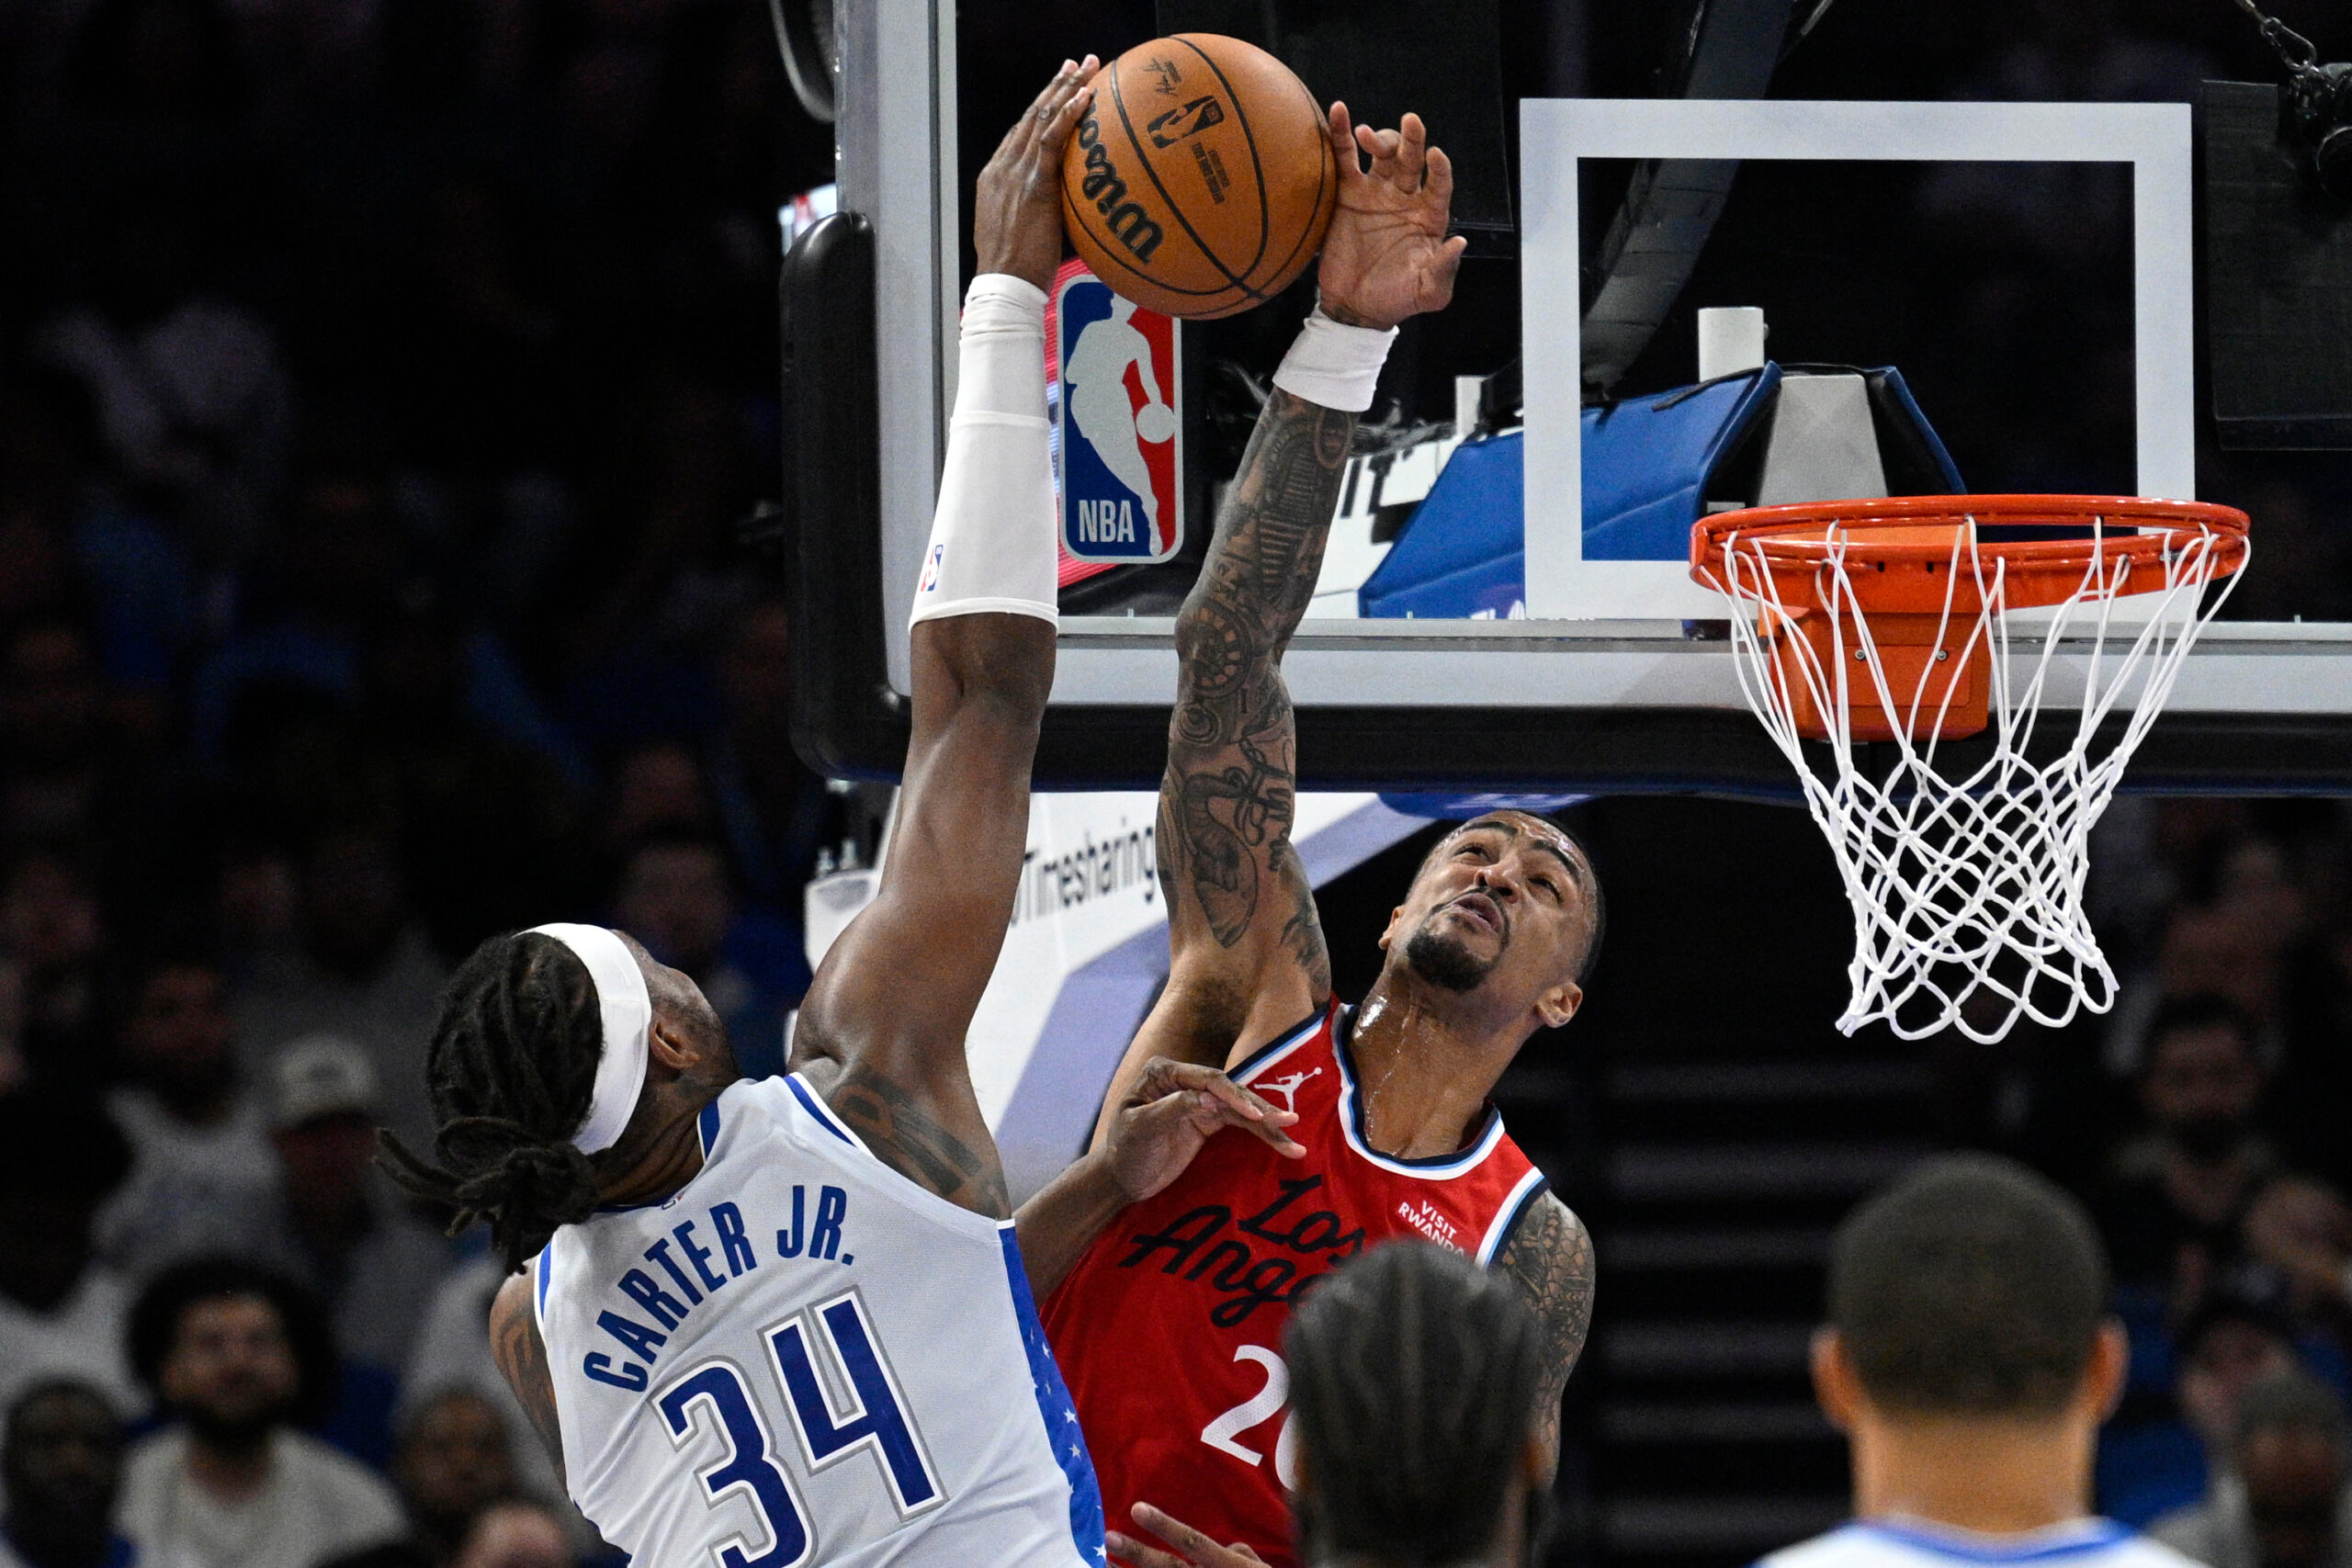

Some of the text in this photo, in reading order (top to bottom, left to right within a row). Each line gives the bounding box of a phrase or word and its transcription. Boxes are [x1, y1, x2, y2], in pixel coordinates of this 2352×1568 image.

[1079, 499, 1136, 543] NBA
[1238, 1173, 1367, 1269] Los
[1421, 1199, 1458, 1240] VISIT
[582, 1184, 854, 1393] CARTER JR.
[648, 1283, 950, 1568] 34
